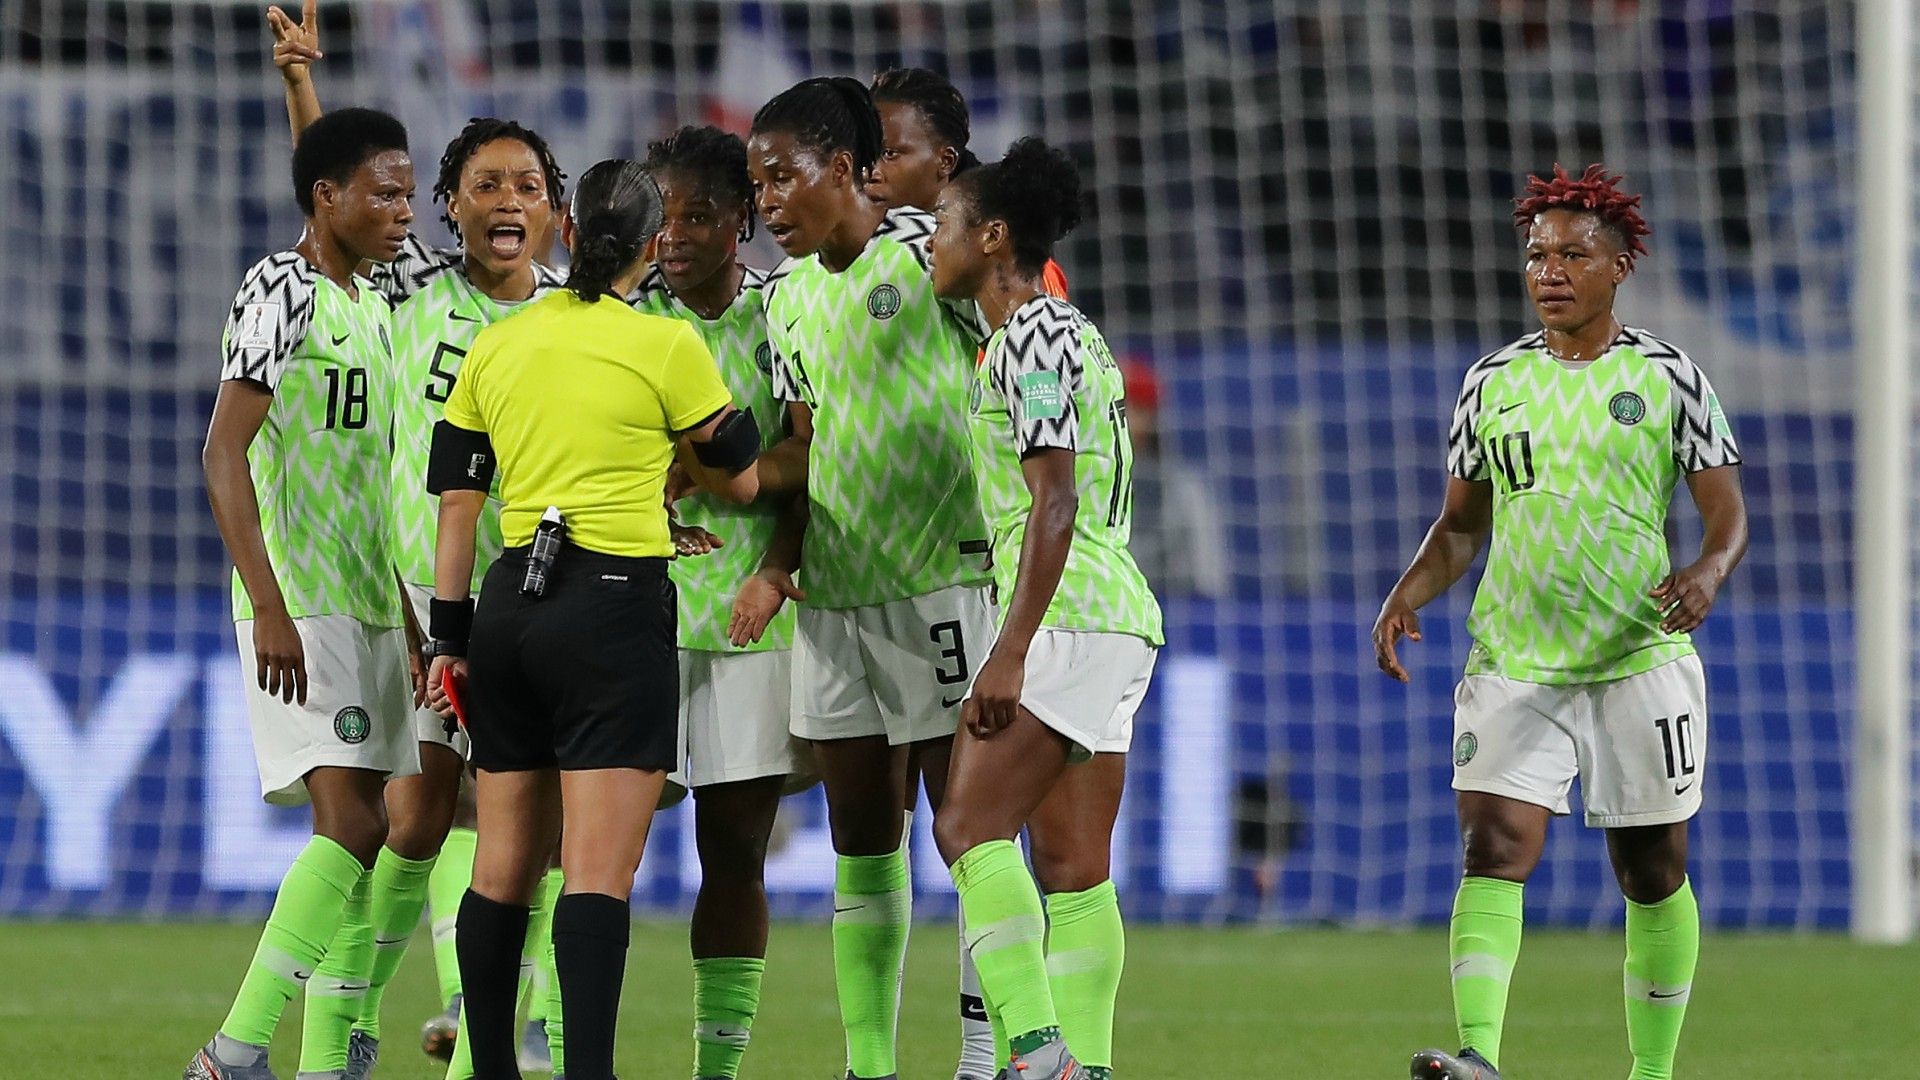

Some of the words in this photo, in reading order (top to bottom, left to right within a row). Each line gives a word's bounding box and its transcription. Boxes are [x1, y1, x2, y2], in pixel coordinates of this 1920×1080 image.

[324, 367, 368, 429] 18
[425, 341, 467, 403] 5
[1489, 431, 1535, 494] 10
[929, 620, 968, 685] 3
[1655, 713, 1695, 778] 10
